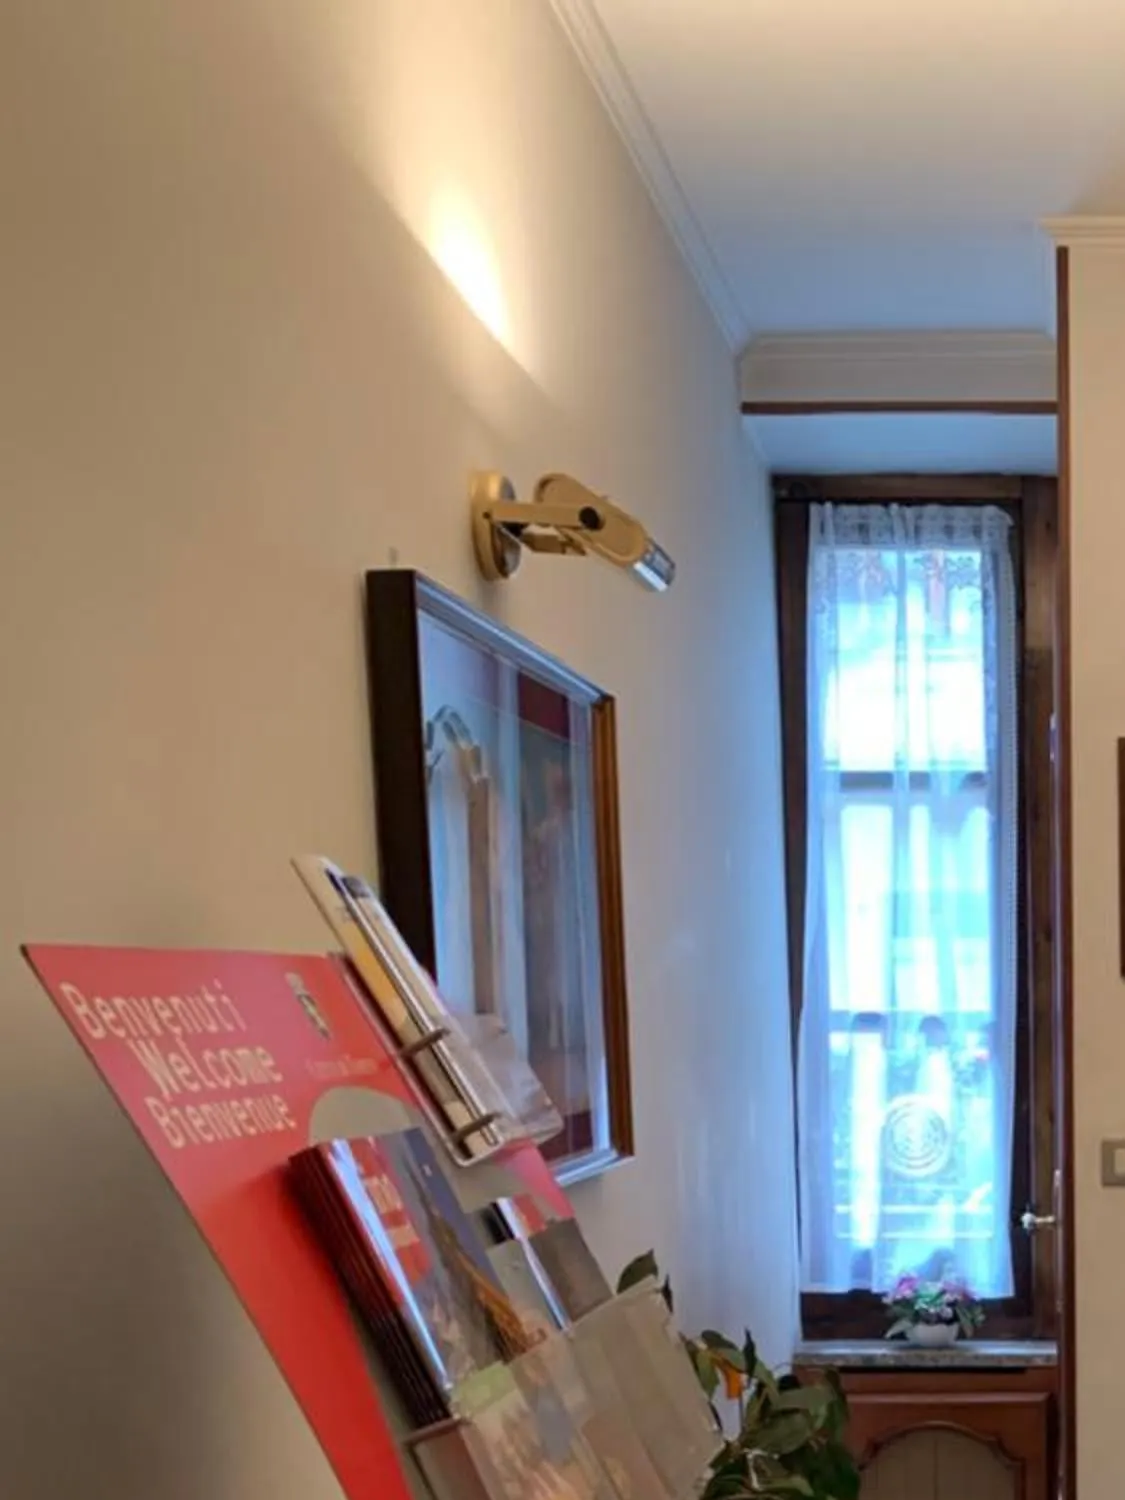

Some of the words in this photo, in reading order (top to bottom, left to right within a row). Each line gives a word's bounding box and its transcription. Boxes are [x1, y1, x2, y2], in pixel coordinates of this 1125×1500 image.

[59, 977, 247, 1040] Benvenuti
[126, 1036, 284, 1102] Welcome
[144, 1094, 297, 1149] Bienvenue
